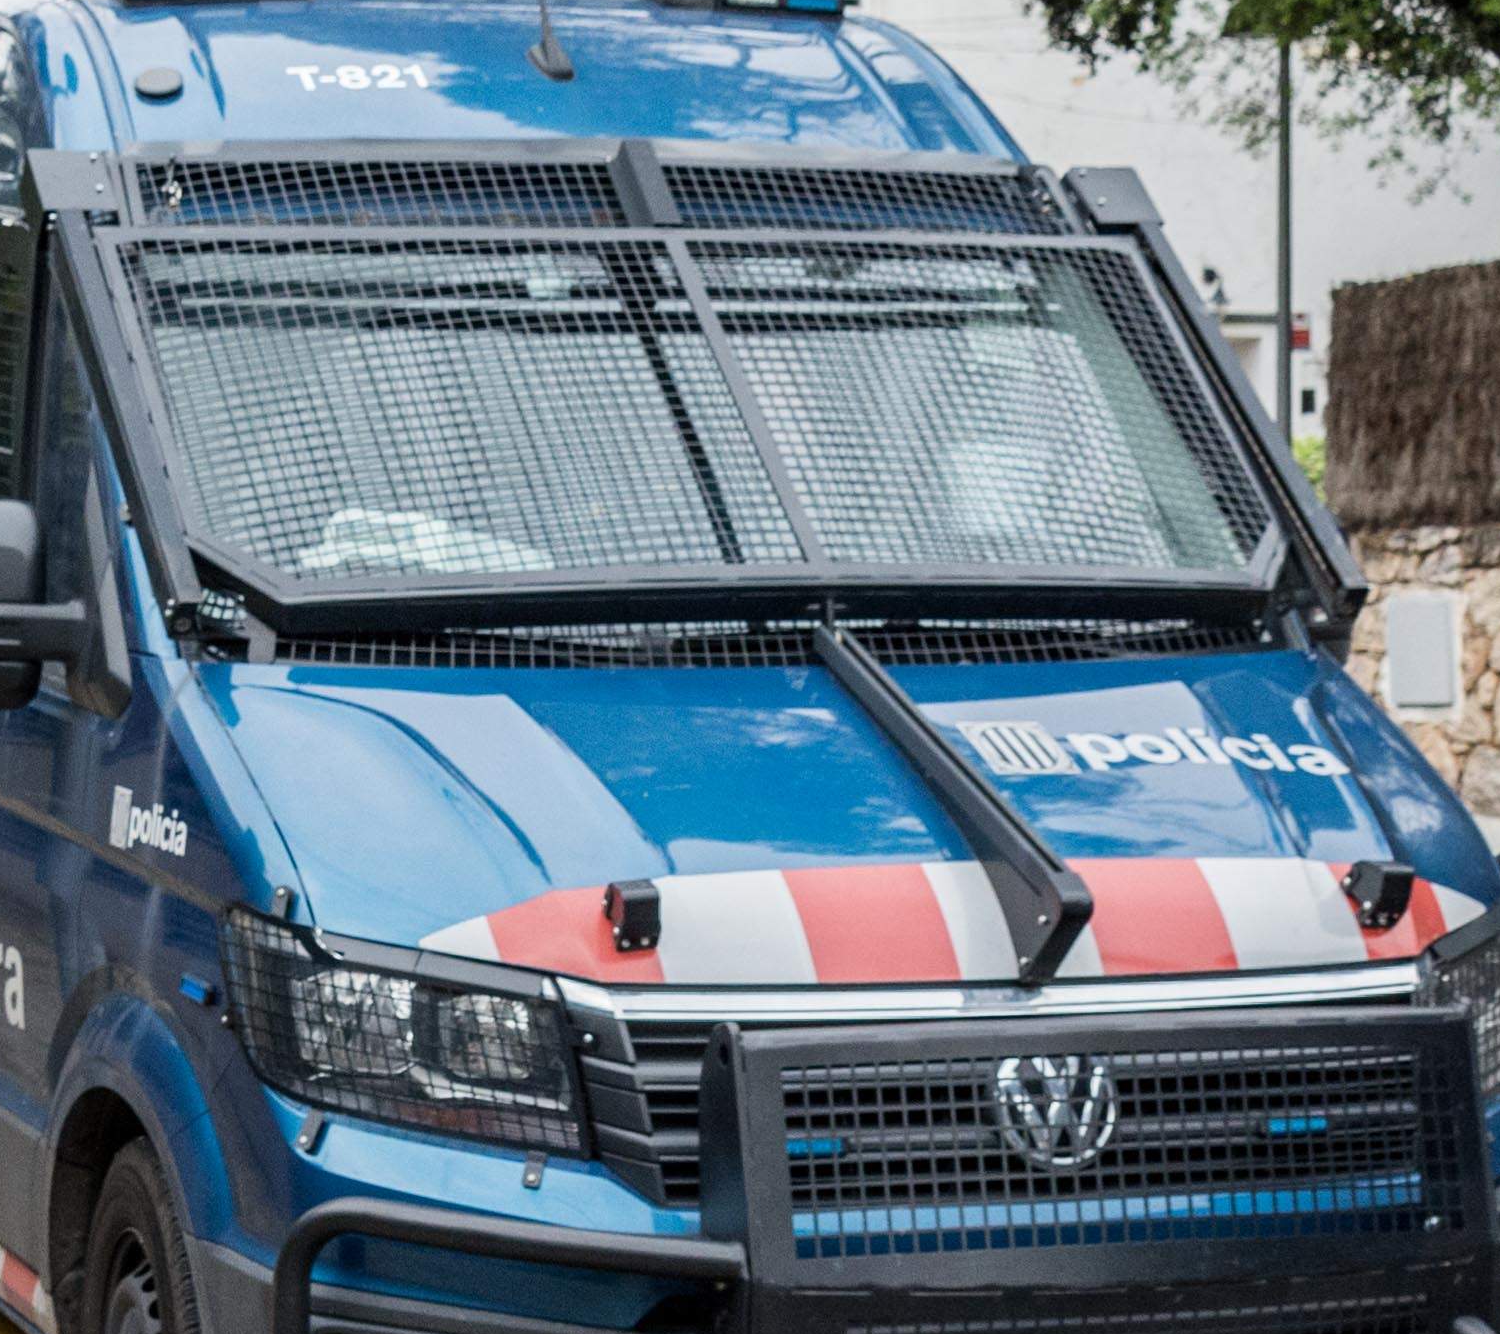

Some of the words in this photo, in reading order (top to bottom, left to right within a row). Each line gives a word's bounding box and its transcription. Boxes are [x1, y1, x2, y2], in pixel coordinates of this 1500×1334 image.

[285, 64, 429, 92] T-821
[1066, 727, 1350, 776] policia
[127, 802, 187, 857] policia
